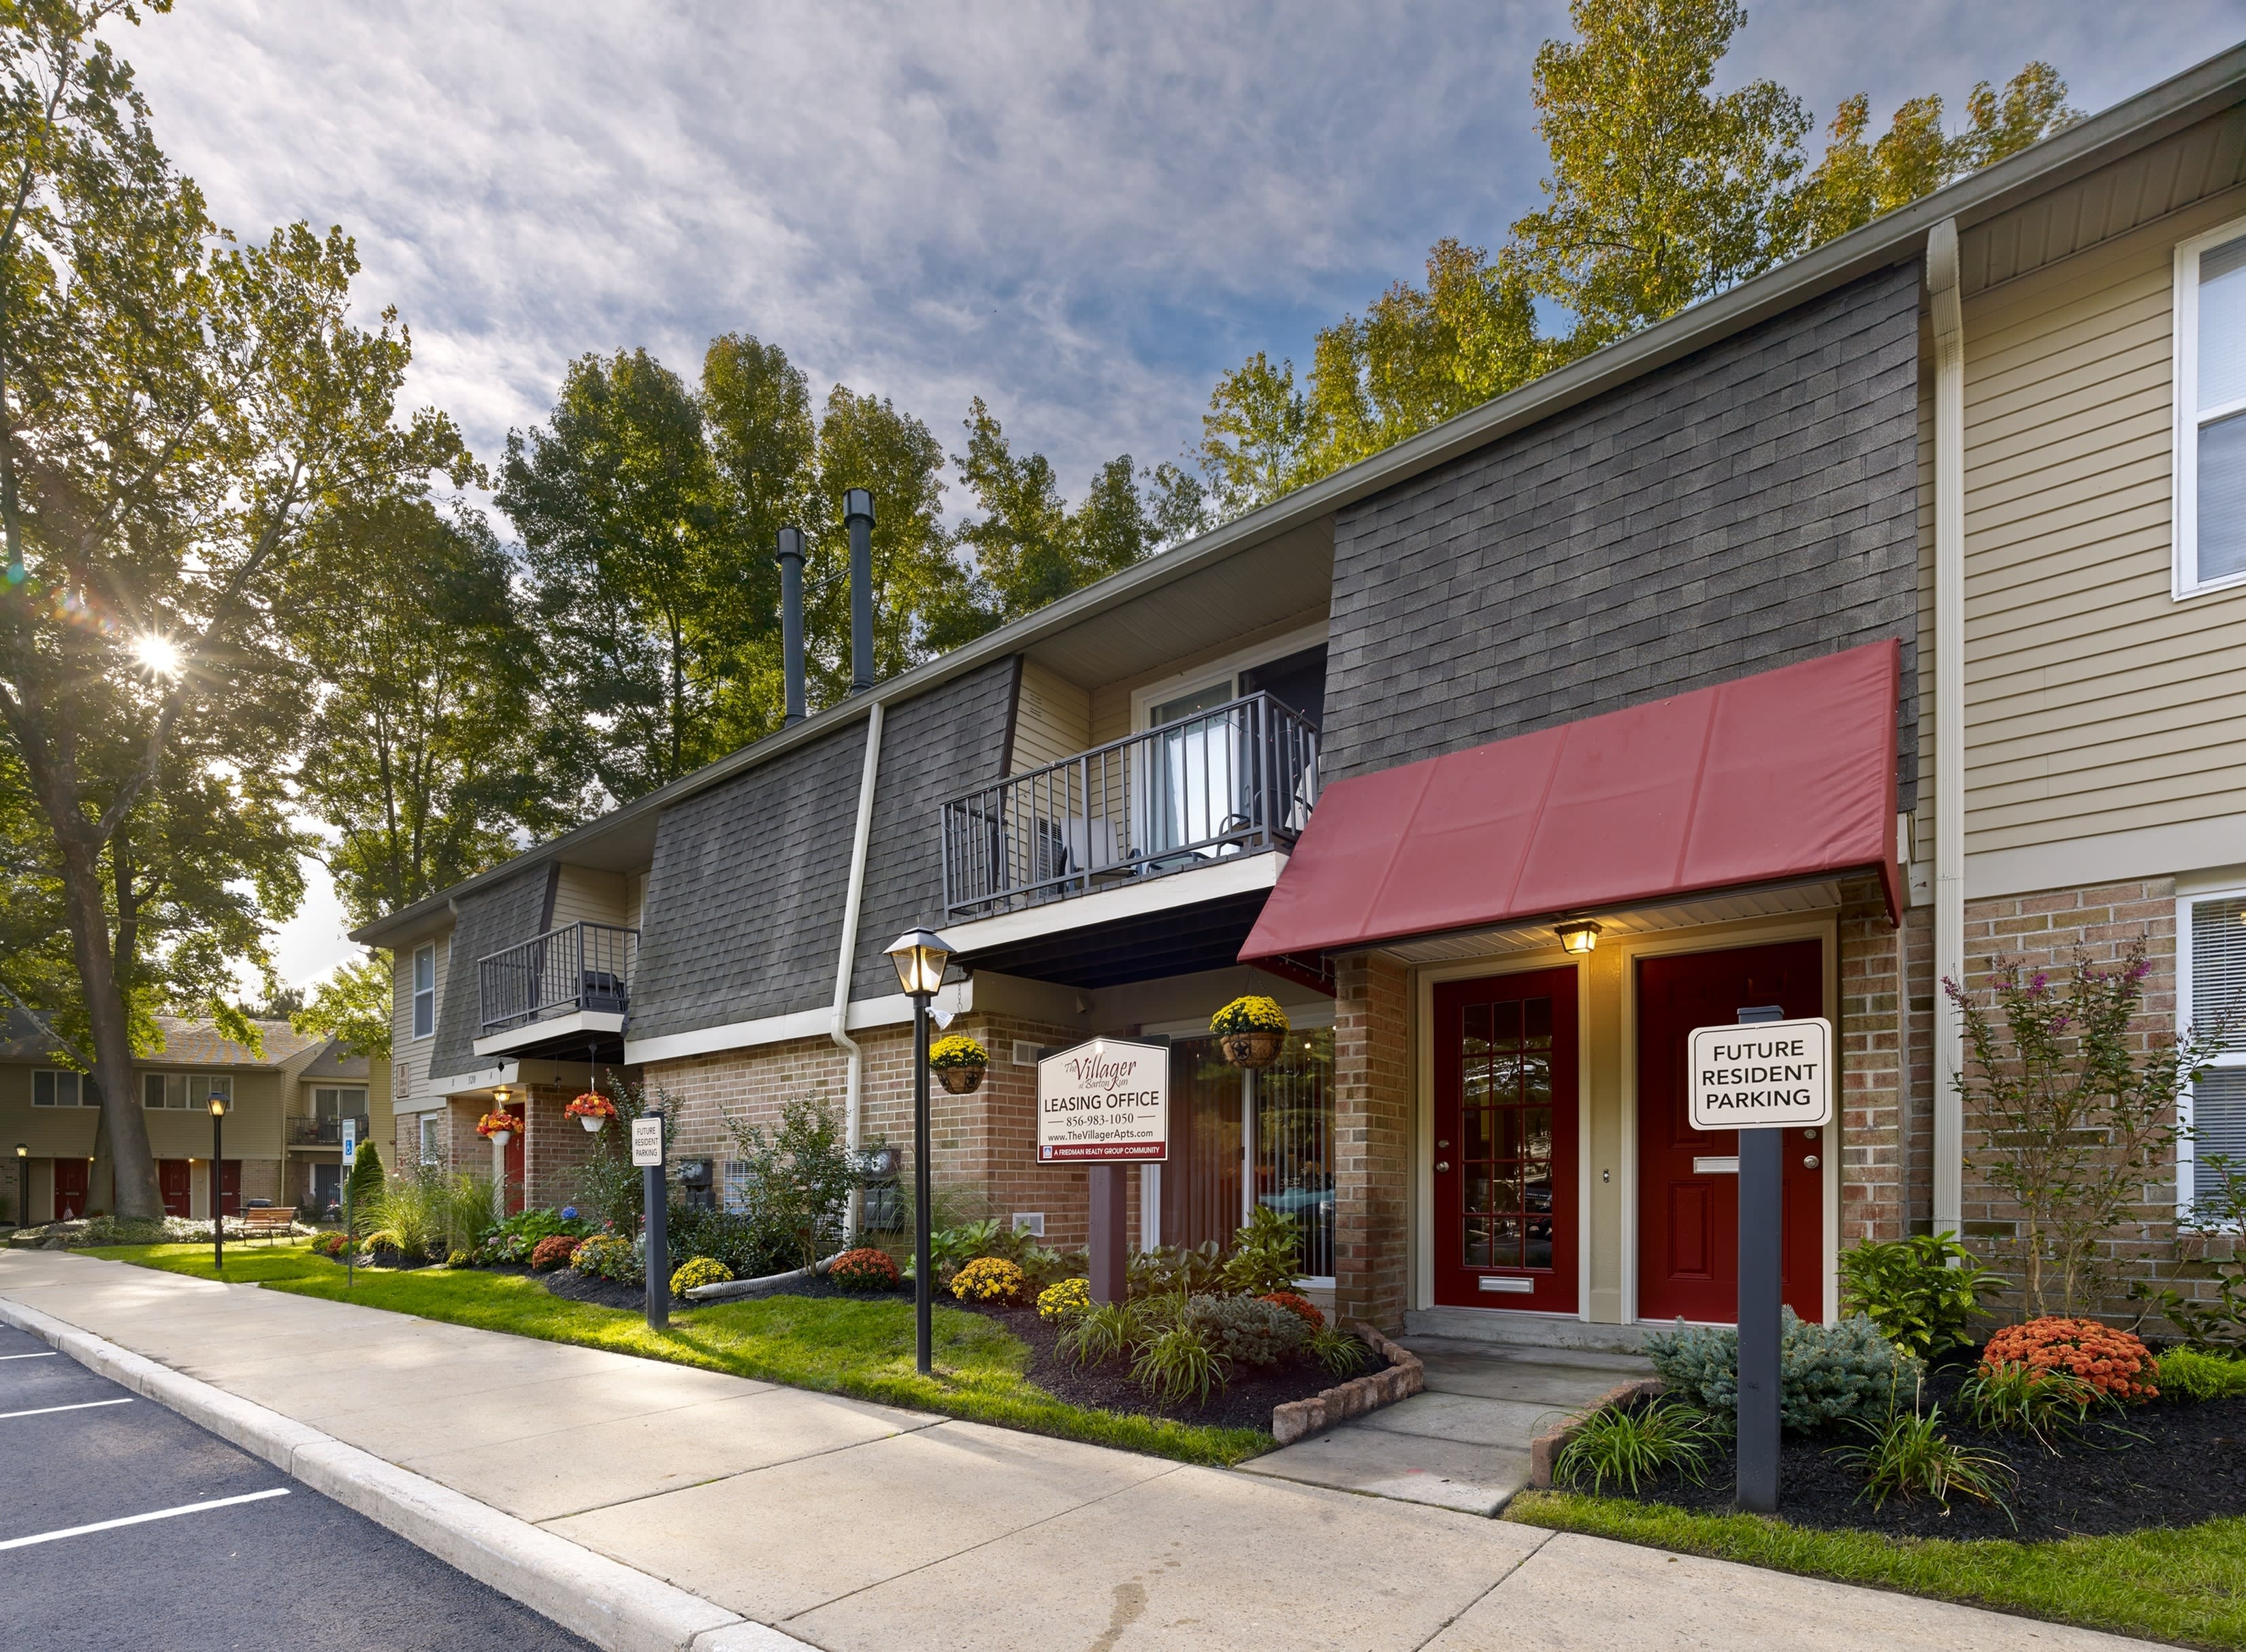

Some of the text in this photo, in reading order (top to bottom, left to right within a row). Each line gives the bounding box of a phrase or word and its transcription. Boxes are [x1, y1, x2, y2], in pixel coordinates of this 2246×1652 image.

[1713, 1039, 1804, 1062] FUTURE
[1064, 1053, 1137, 1091] The Villager
[1702, 1063, 1818, 1086] RESIDENT
[1078, 1081, 1084, 1089] at
[1085, 1078, 1109, 1088] Barton
[1045, 1091, 1159, 1112] LEASING OFFICE
[1706, 1089, 1811, 1110] PARKING
[1067, 1113, 1134, 1127] 856-983-1050
[637, 1127, 655, 1135] FUTURE
[1048, 1129, 1153, 1141] www.TheVillagerApts.com
[635, 1138, 658, 1146] RESIDENT
